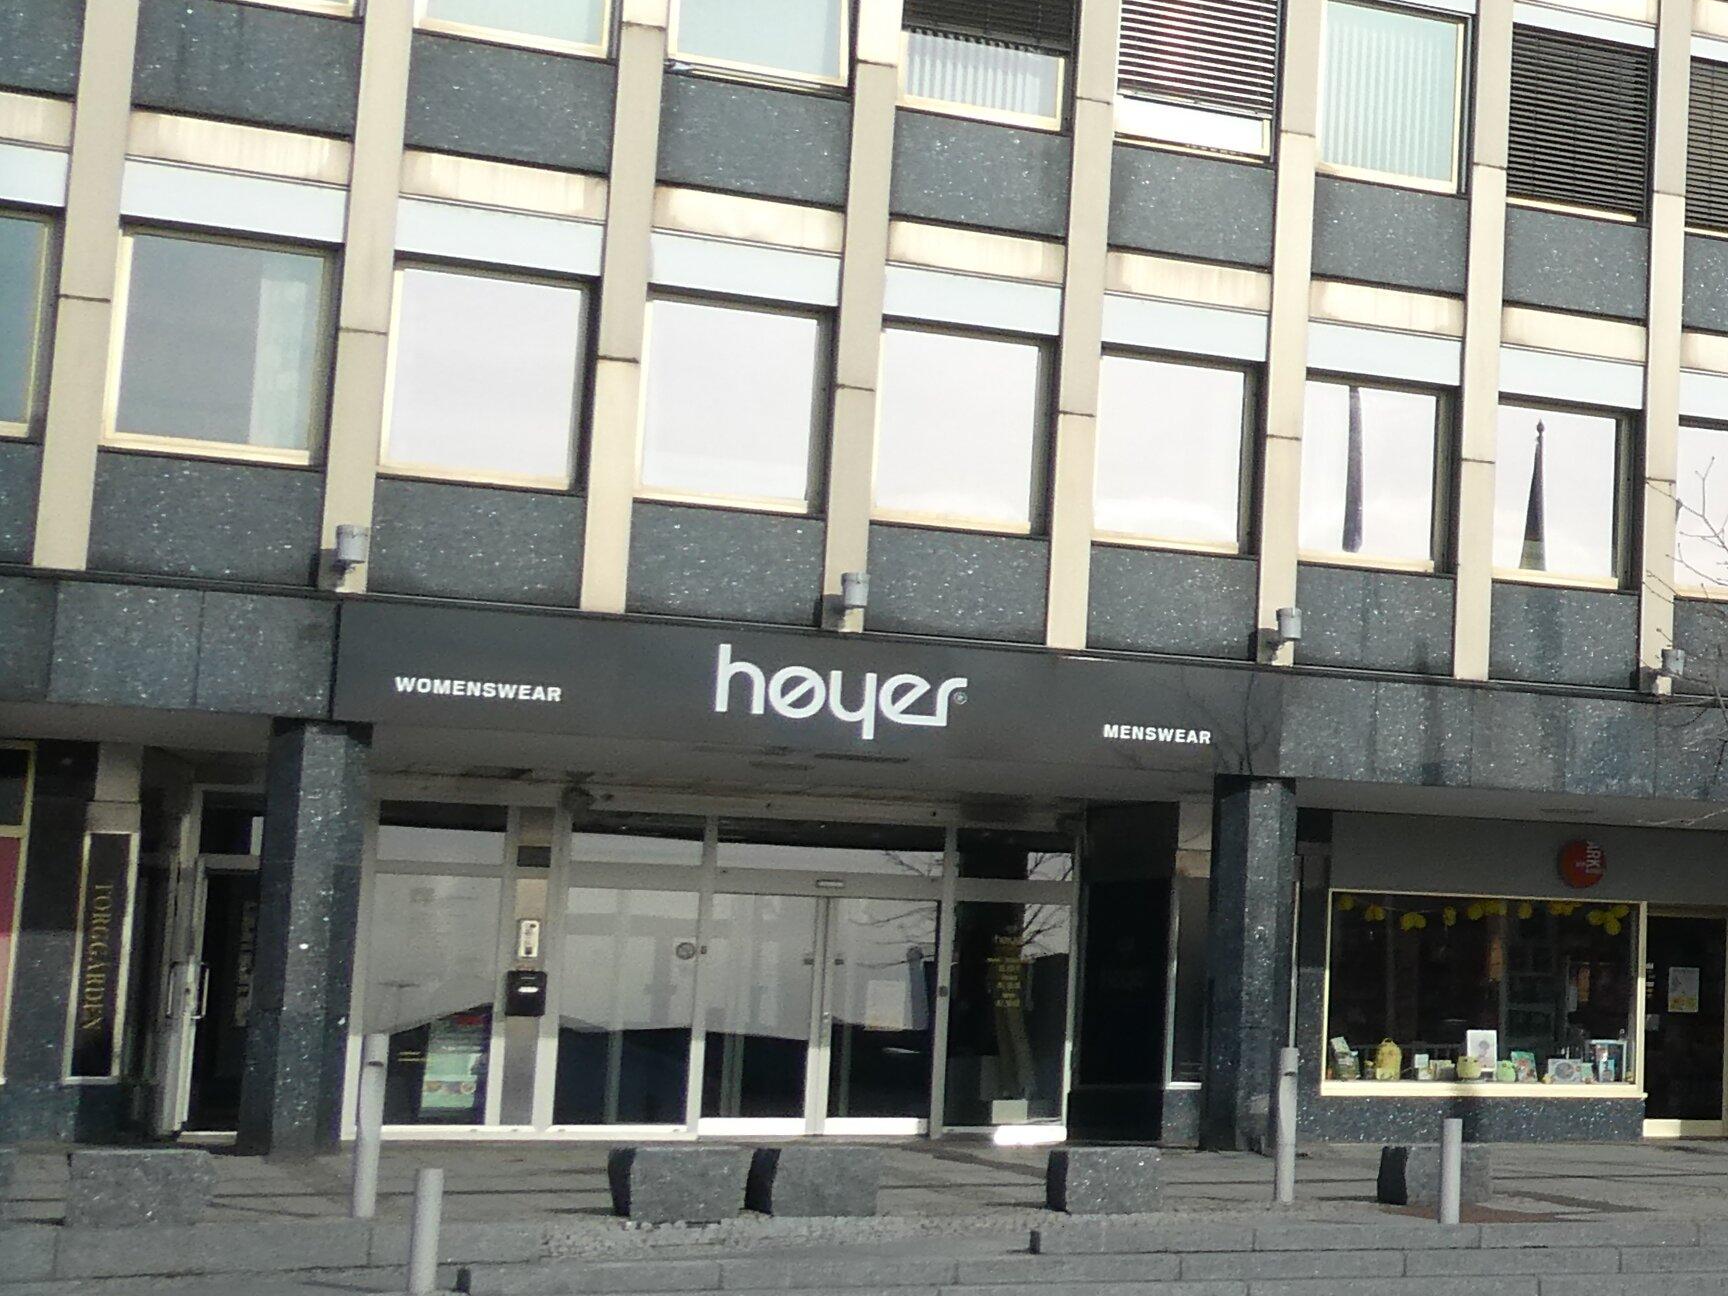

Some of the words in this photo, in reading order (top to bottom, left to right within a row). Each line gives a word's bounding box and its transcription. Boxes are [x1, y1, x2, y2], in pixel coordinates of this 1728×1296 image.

[395, 676, 561, 703] WOMENSWEAR
[715, 643, 968, 740] høyer
[1103, 723, 1211, 745] MENSWEAR
